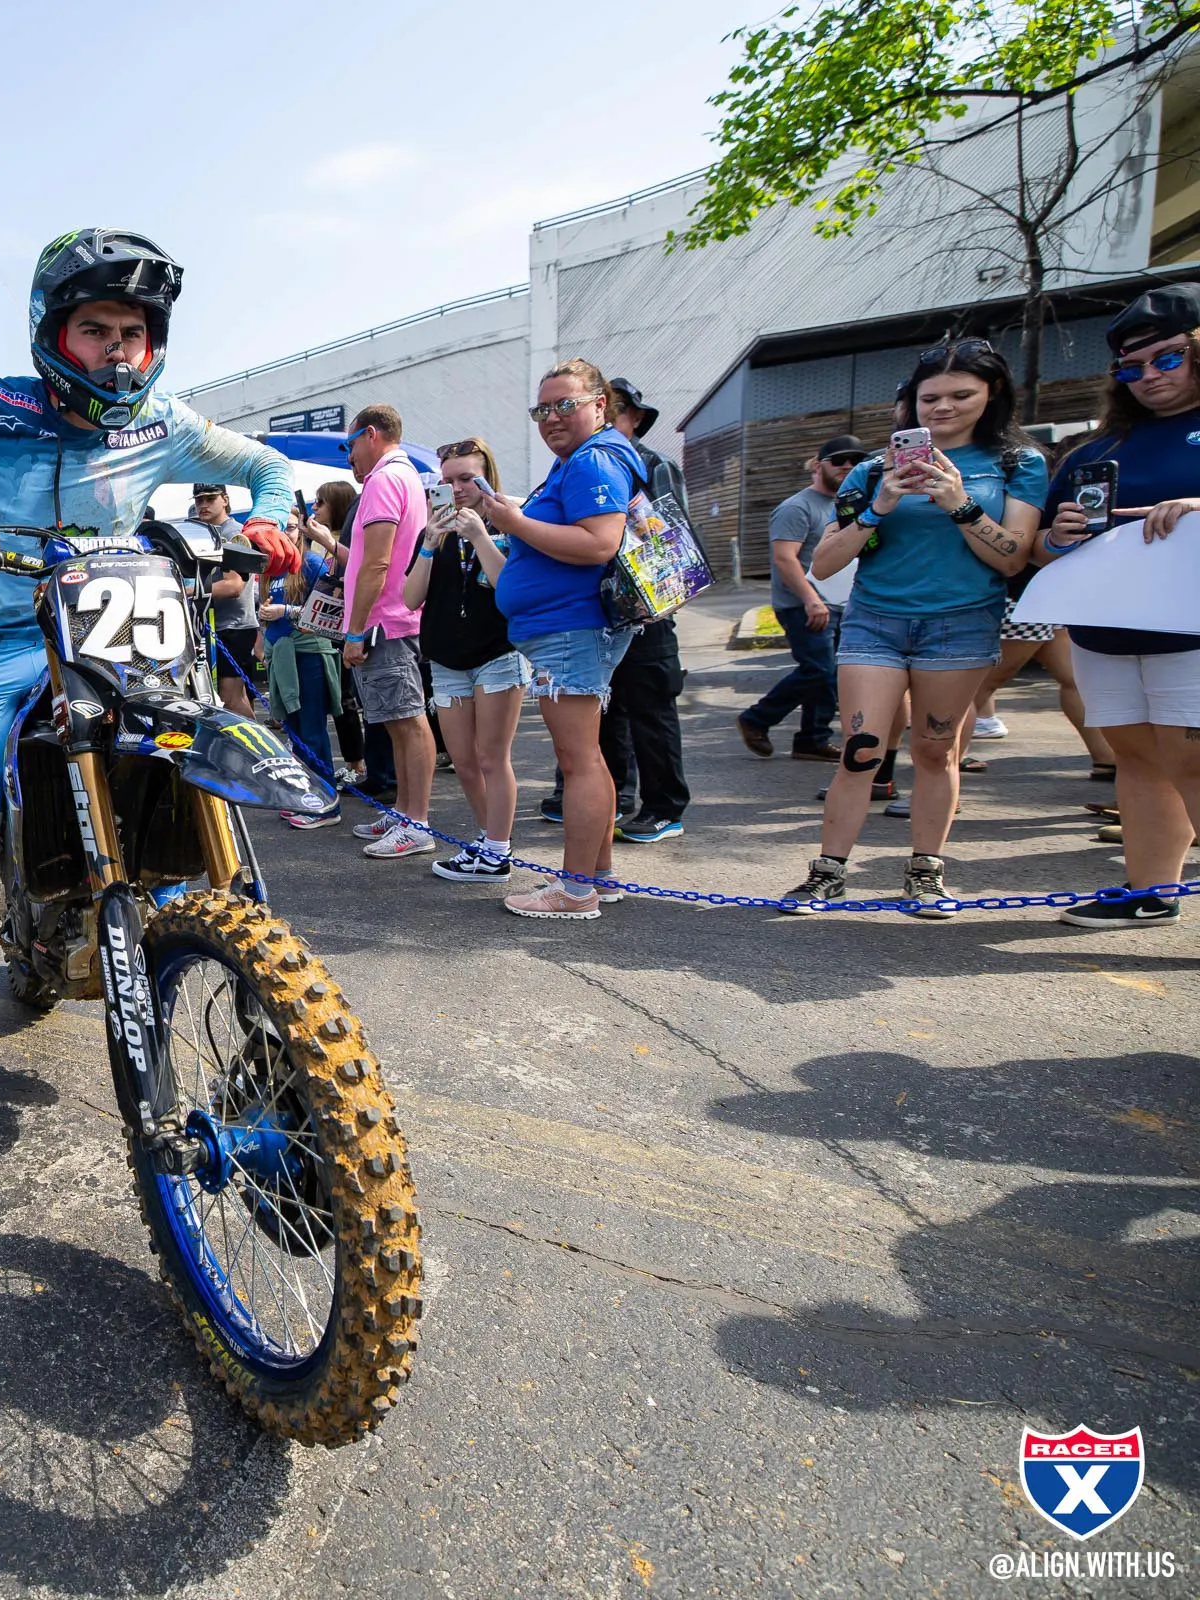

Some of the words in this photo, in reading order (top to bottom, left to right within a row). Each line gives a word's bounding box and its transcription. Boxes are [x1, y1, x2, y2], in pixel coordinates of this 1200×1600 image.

[119, 425, 165, 447] YAMAHA
[77, 576, 186, 662] 25
[101, 946, 116, 1004] BRAKING
[108, 924, 147, 1073] DUNLOP
